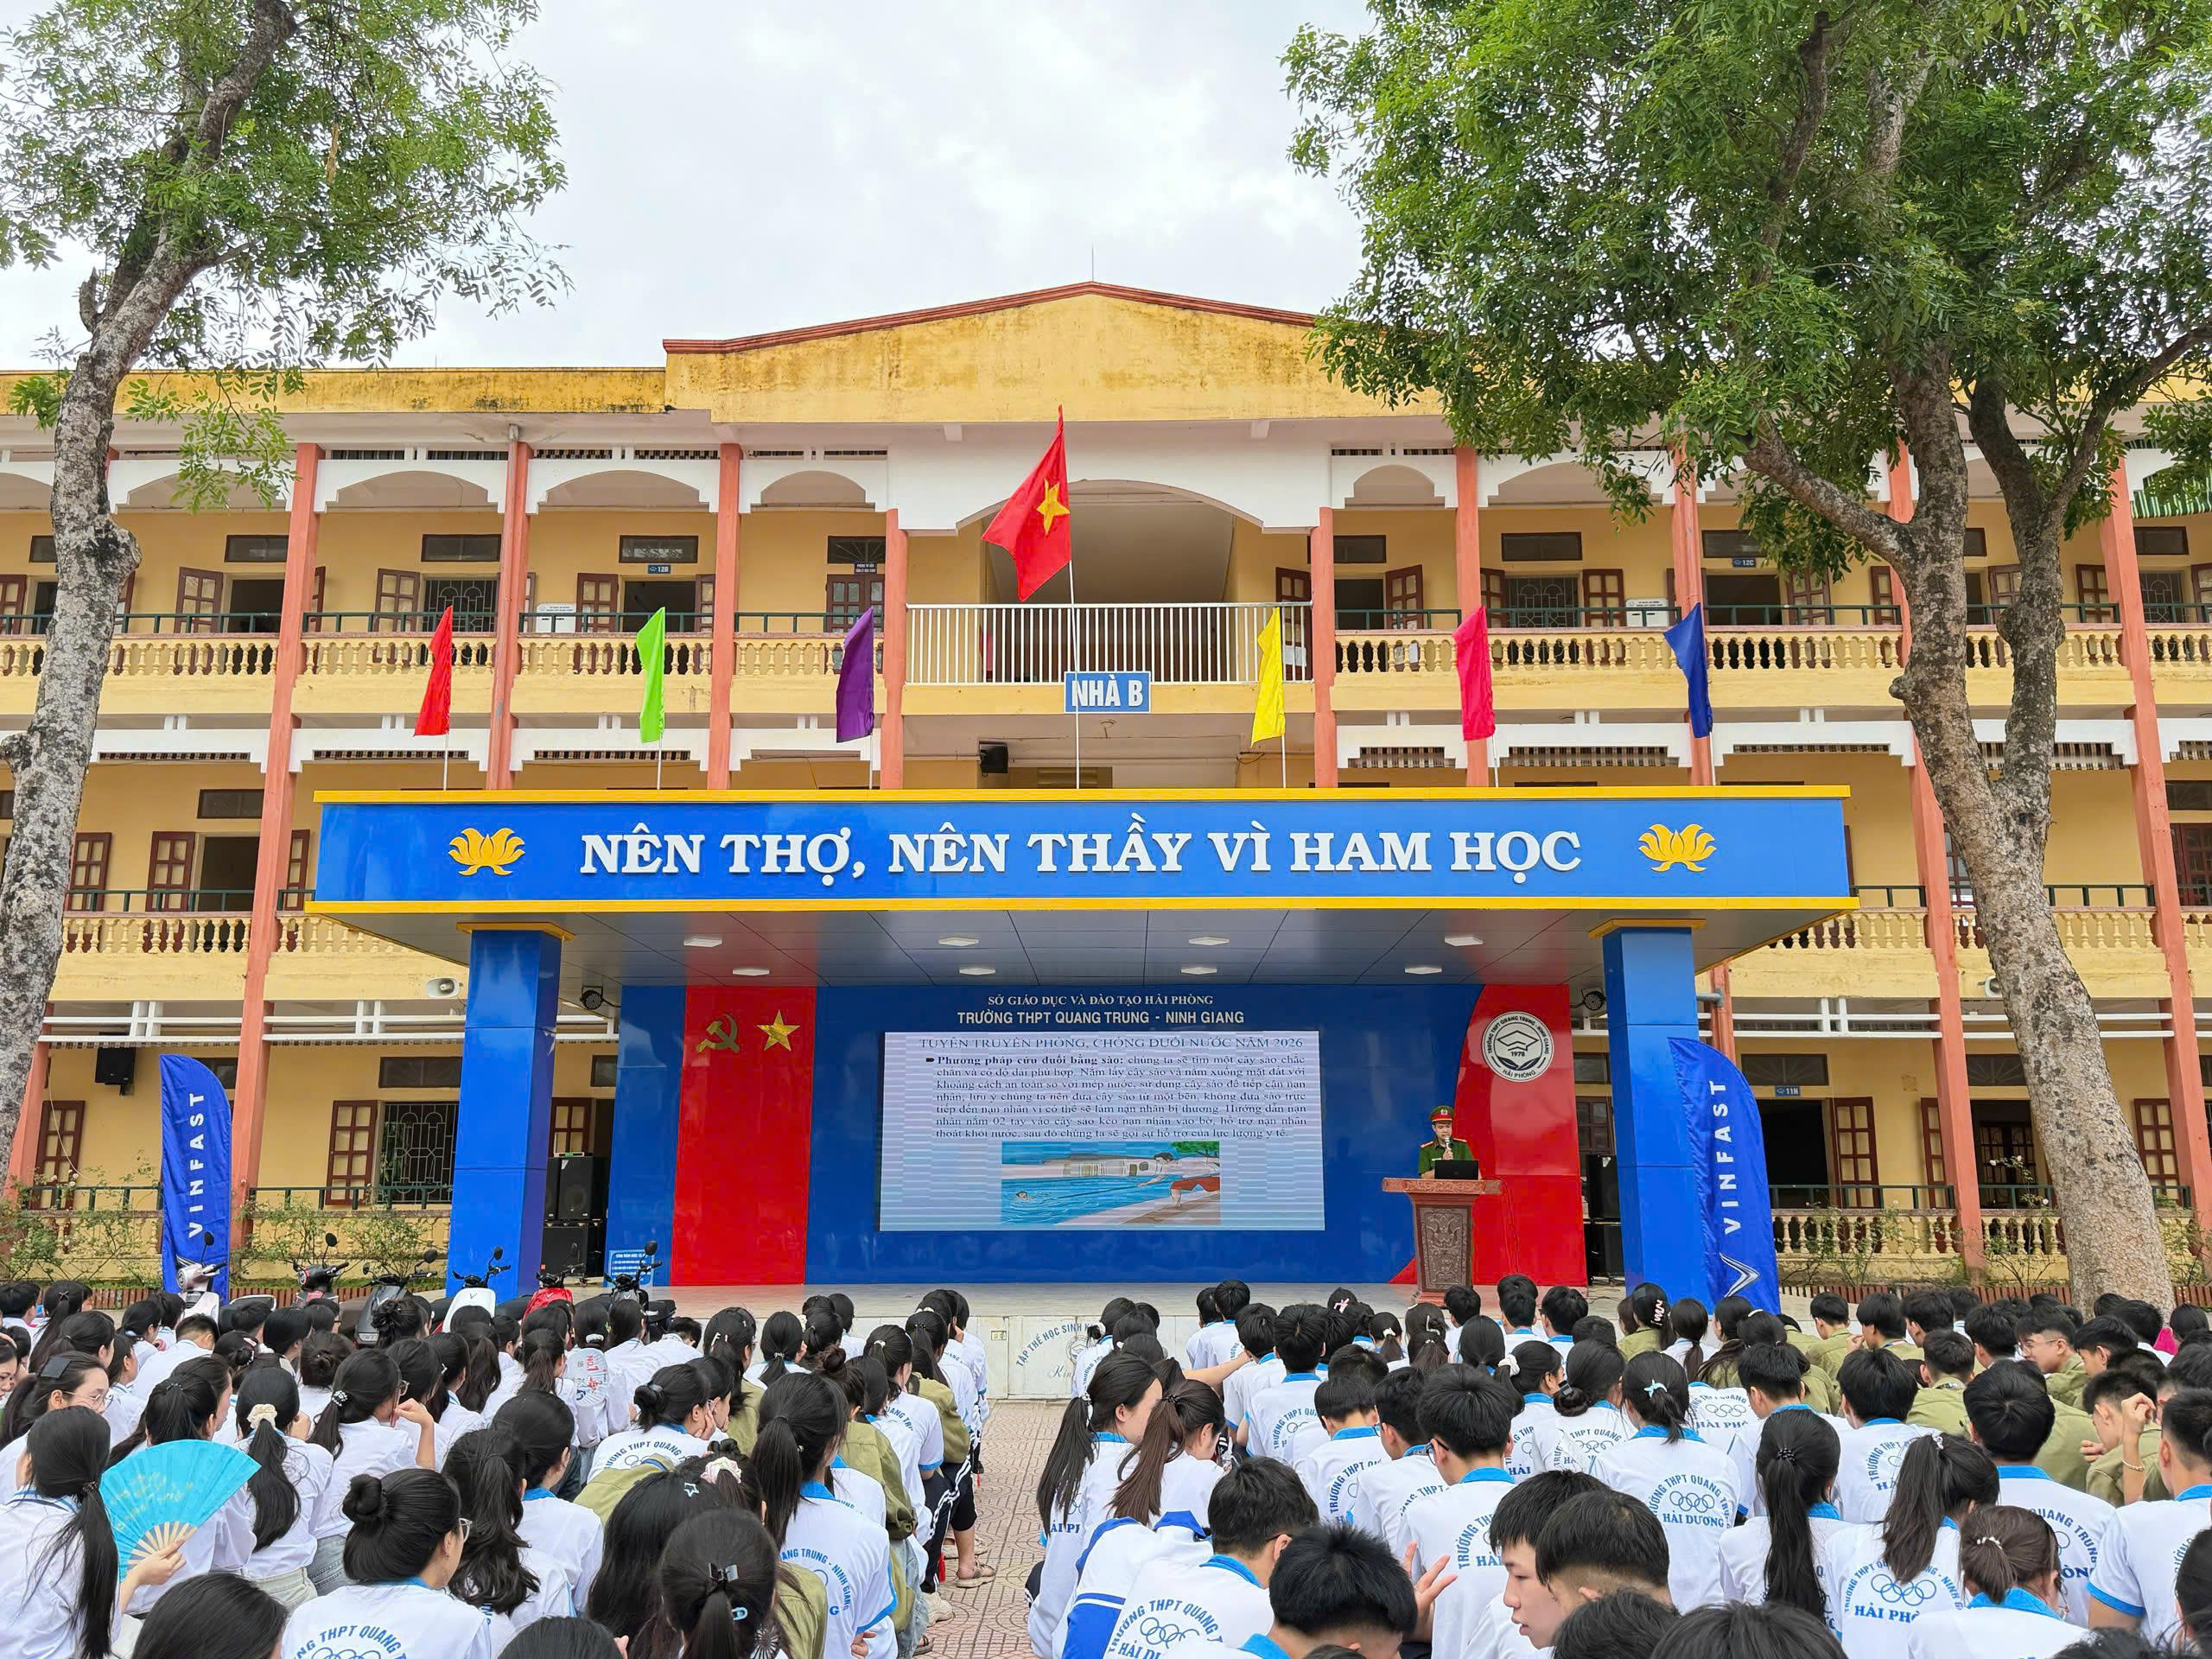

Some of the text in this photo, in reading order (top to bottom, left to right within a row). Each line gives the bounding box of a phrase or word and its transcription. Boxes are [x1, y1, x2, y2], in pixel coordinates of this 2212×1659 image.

[1071, 674, 1143, 707] NHÀ B
[581, 812, 1582, 887] NÊN THỢ, NÊN THẦY VÌ HAM HỌC
[988, 994, 1213, 1007] SỞ GIÁO DỤC VÀ ĐÀO TẠO HẢI PHÒNG
[957, 1008, 1013, 1024] TRƯỜNG
[1017, 1011, 1052, 1024] THPT
[1055, 1011, 1101, 1024] QUANG
[1104, 1011, 1149, 1024] TRUNG
[1166, 1011, 1197, 1024] NINH
[1200, 1011, 1244, 1024] GIANG
[1274, 1038, 1303, 1047] 2026
[1514, 1070, 1536, 1078] PHÒNG
[188, 1093, 205, 1238] VINFAST
[1708, 1080, 1741, 1235] VINFAST
[1061, 1323, 1082, 1333] SINH
[1284, 1408, 1302, 1421] THPT
[1518, 1426, 1535, 1439] THP
[1569, 1428, 1623, 1442] THPT QUANG
[628, 1441, 652, 1451] THPT
[653, 1441, 683, 1457] QUANG
[1342, 1461, 1365, 1478] THPT
[1417, 1484, 1444, 1497] THPT
[1648, 1484, 1668, 1514] ƯỜNG
[1664, 1474, 1688, 1488] THPT
[1690, 1474, 1722, 1497] QUANG
[1050, 1519, 1063, 1533] ẢI
[1662, 1510, 1725, 1529] HẢI DƯƠNG
[1455, 1523, 1479, 1570] TRƯỜNG
[781, 1548, 799, 1561] ANG
[801, 1548, 829, 1564] TRUNG
[831, 1564, 848, 1586] NINH
[1854, 1563, 1875, 1580] THPT
[1941, 1576, 1961, 1599] NINH
[1149, 1599, 1183, 1612] THPT
[1183, 1603, 1218, 1636] QUANG
[1854, 1602, 1885, 1619] HẢI
[320, 1624, 402, 1655] THPT QUANG
